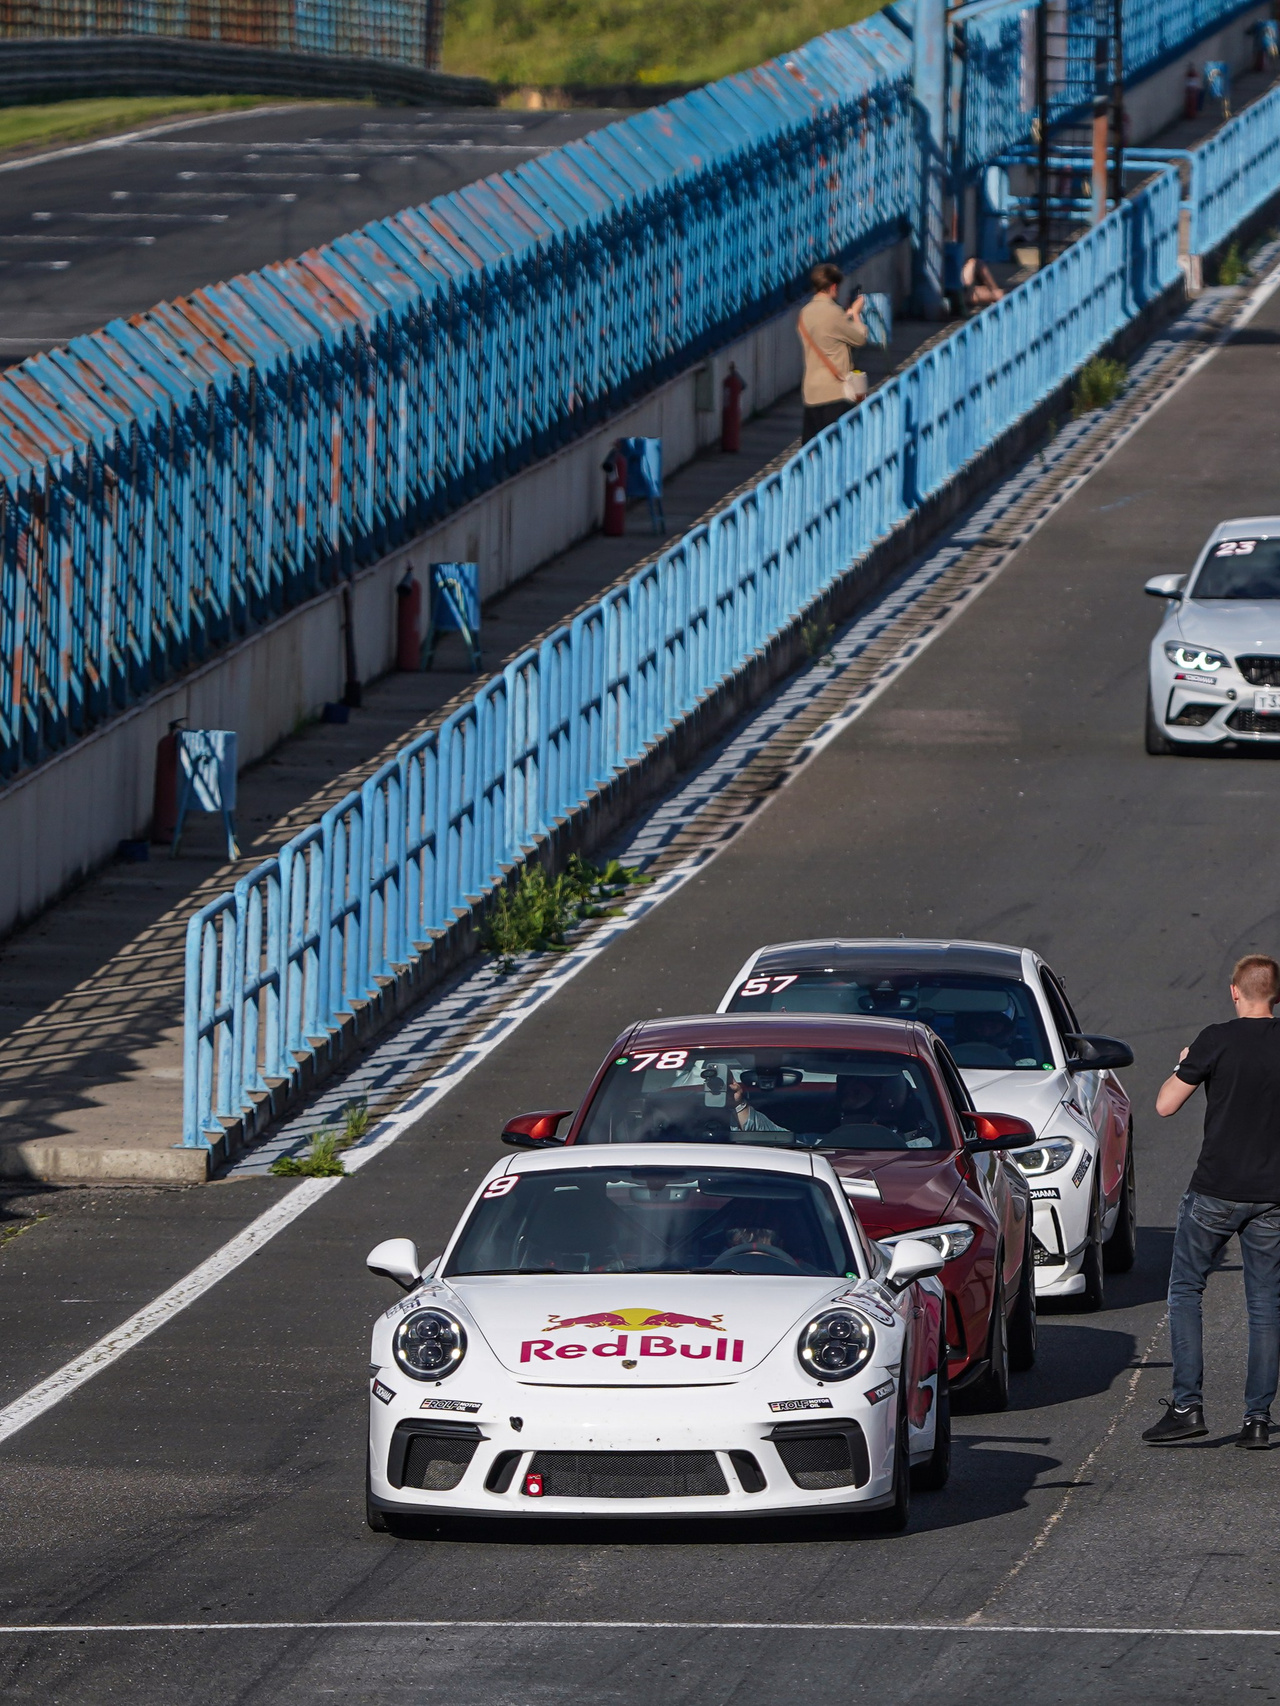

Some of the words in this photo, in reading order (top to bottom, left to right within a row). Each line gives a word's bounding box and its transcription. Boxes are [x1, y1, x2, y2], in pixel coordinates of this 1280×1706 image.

[1215, 541, 1257, 557] 23
[740, 974, 799, 997] 57
[630, 1050, 689, 1073] 78
[482, 1174, 520, 1199] 9
[1030, 1189, 1058, 1199] OHAMA
[520, 1334, 628, 1363] Red
[639, 1335, 744, 1363] Bull
[429, 1399, 461, 1411] ROLF
[778, 1399, 809, 1411] ROLF
